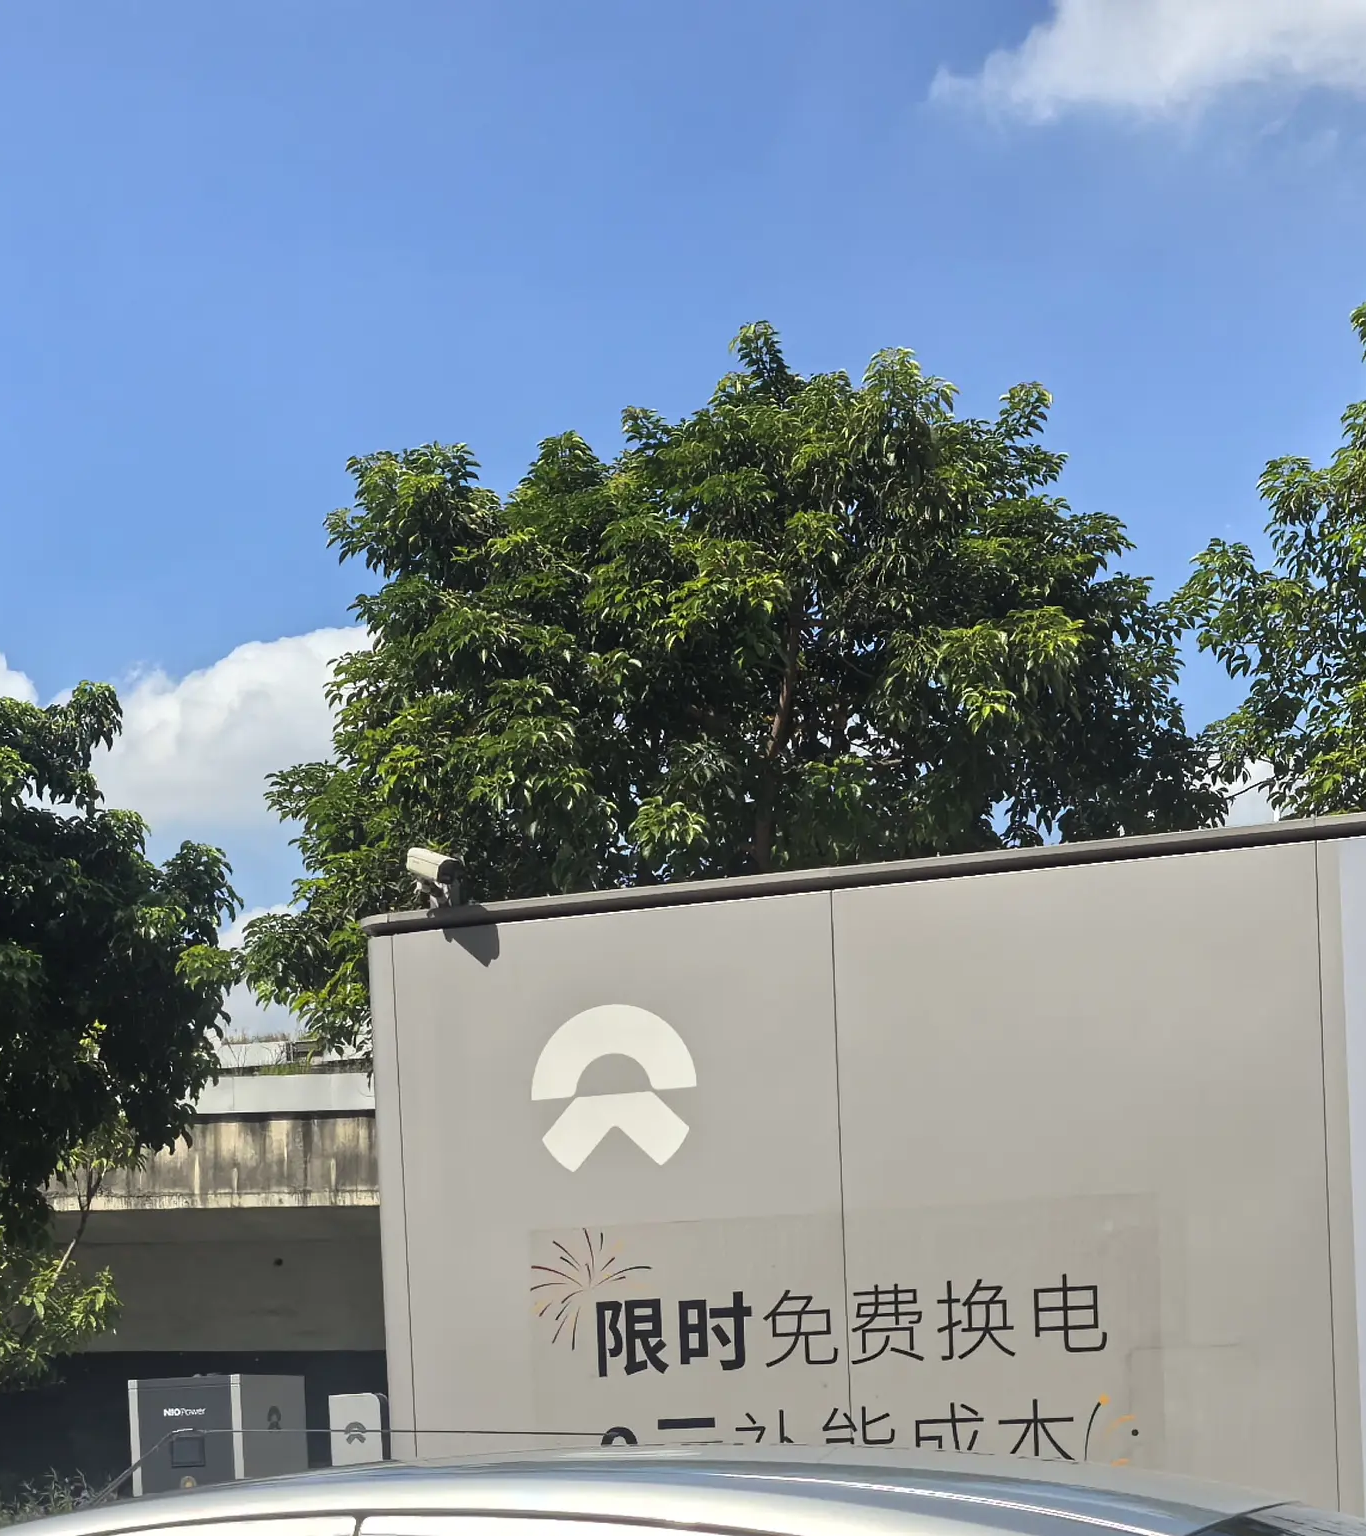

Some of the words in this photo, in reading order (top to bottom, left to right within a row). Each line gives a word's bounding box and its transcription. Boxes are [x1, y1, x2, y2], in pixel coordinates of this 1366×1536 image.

[596, 1273, 1109, 1378] 限时免费换电
